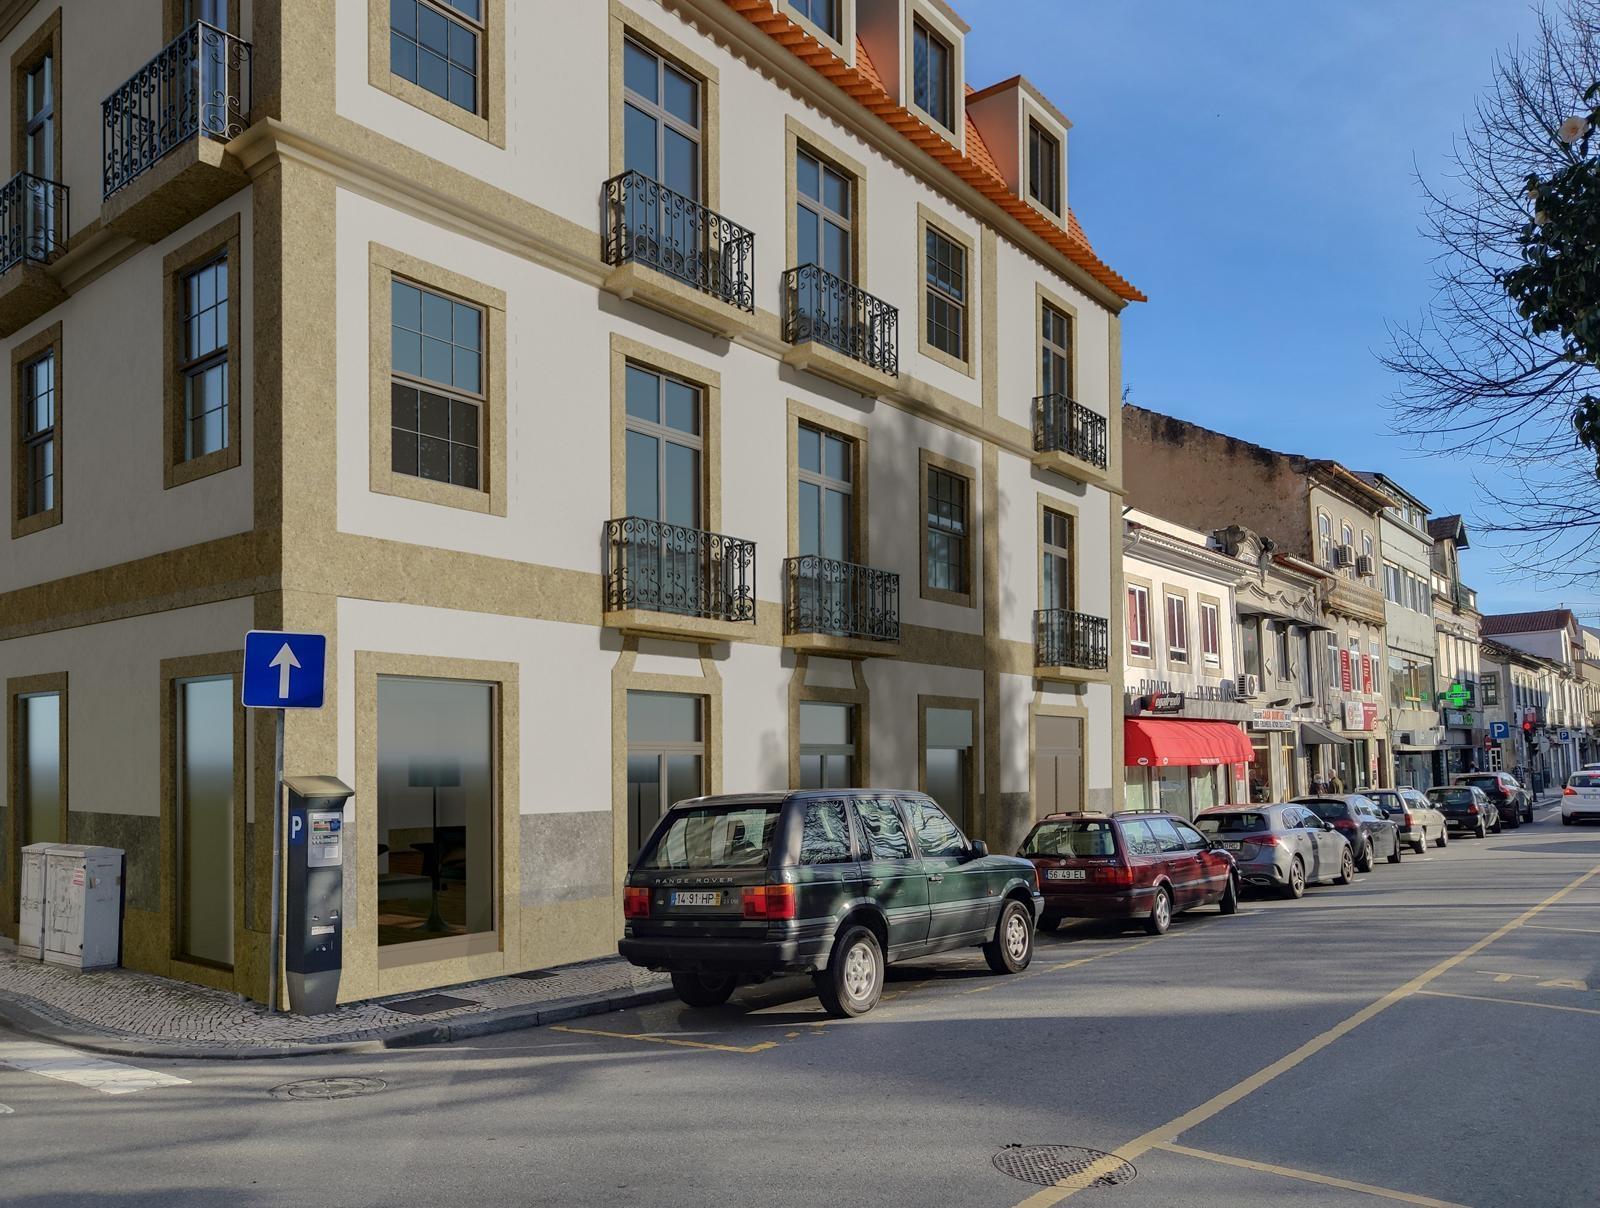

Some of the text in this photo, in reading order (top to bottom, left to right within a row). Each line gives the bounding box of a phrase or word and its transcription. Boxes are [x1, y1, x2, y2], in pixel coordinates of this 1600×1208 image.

[1494, 723, 1505, 737] P
[1561, 732, 1568, 740] P
[291, 815, 303, 839] P
[1048, 870, 1085, 879] 56 49 EL
